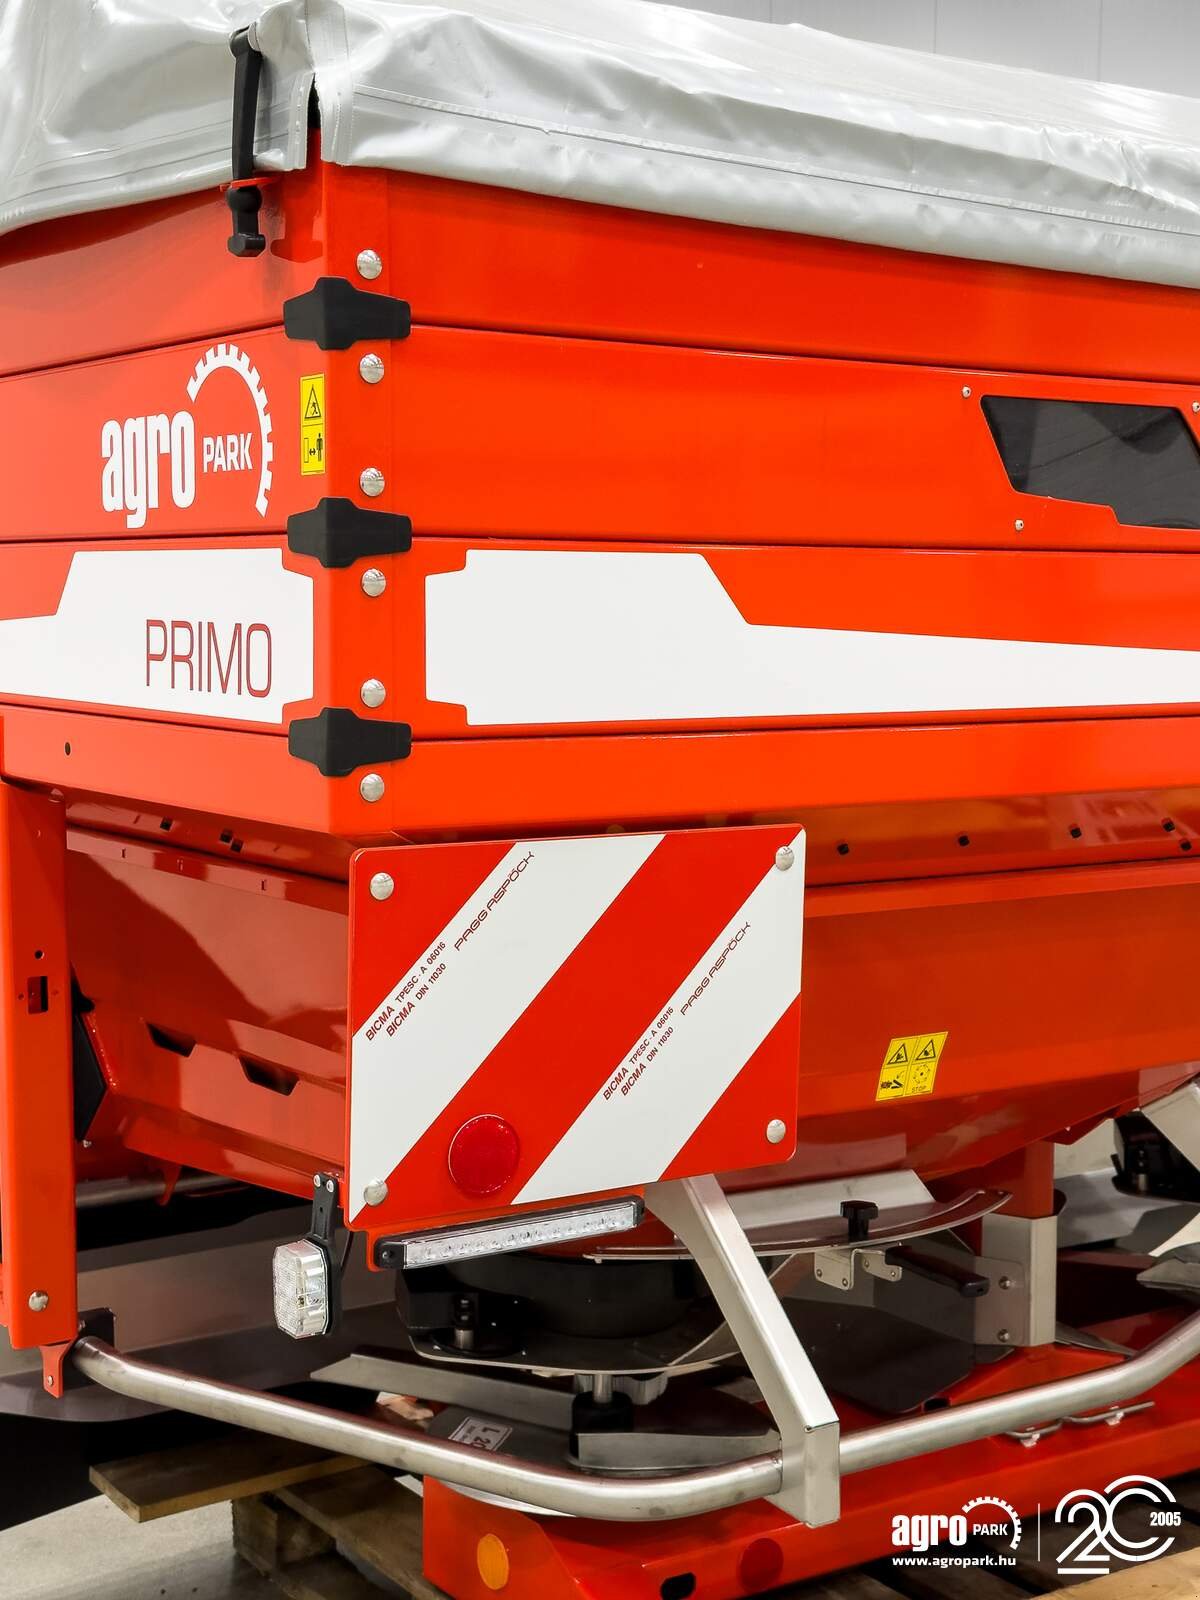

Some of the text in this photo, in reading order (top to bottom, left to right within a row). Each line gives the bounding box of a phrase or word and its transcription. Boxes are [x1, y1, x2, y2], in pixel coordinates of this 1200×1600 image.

[101, 411, 253, 529] agro PARK
[146, 619, 272, 698] PRIMO
[454, 851, 535, 951] PAGG ASPÖCK
[365, 1005, 395, 1041] BICMA
[426, 942, 446, 965] 06016
[386, 963, 447, 1037] BICMA DIN 11030
[680, 922, 751, 1016] PAGG ASPÖCK
[603, 1066, 629, 1100] BICMA
[656, 1007, 674, 1029] 06016
[620, 1026, 674, 1096] BICMA DIN 11030
